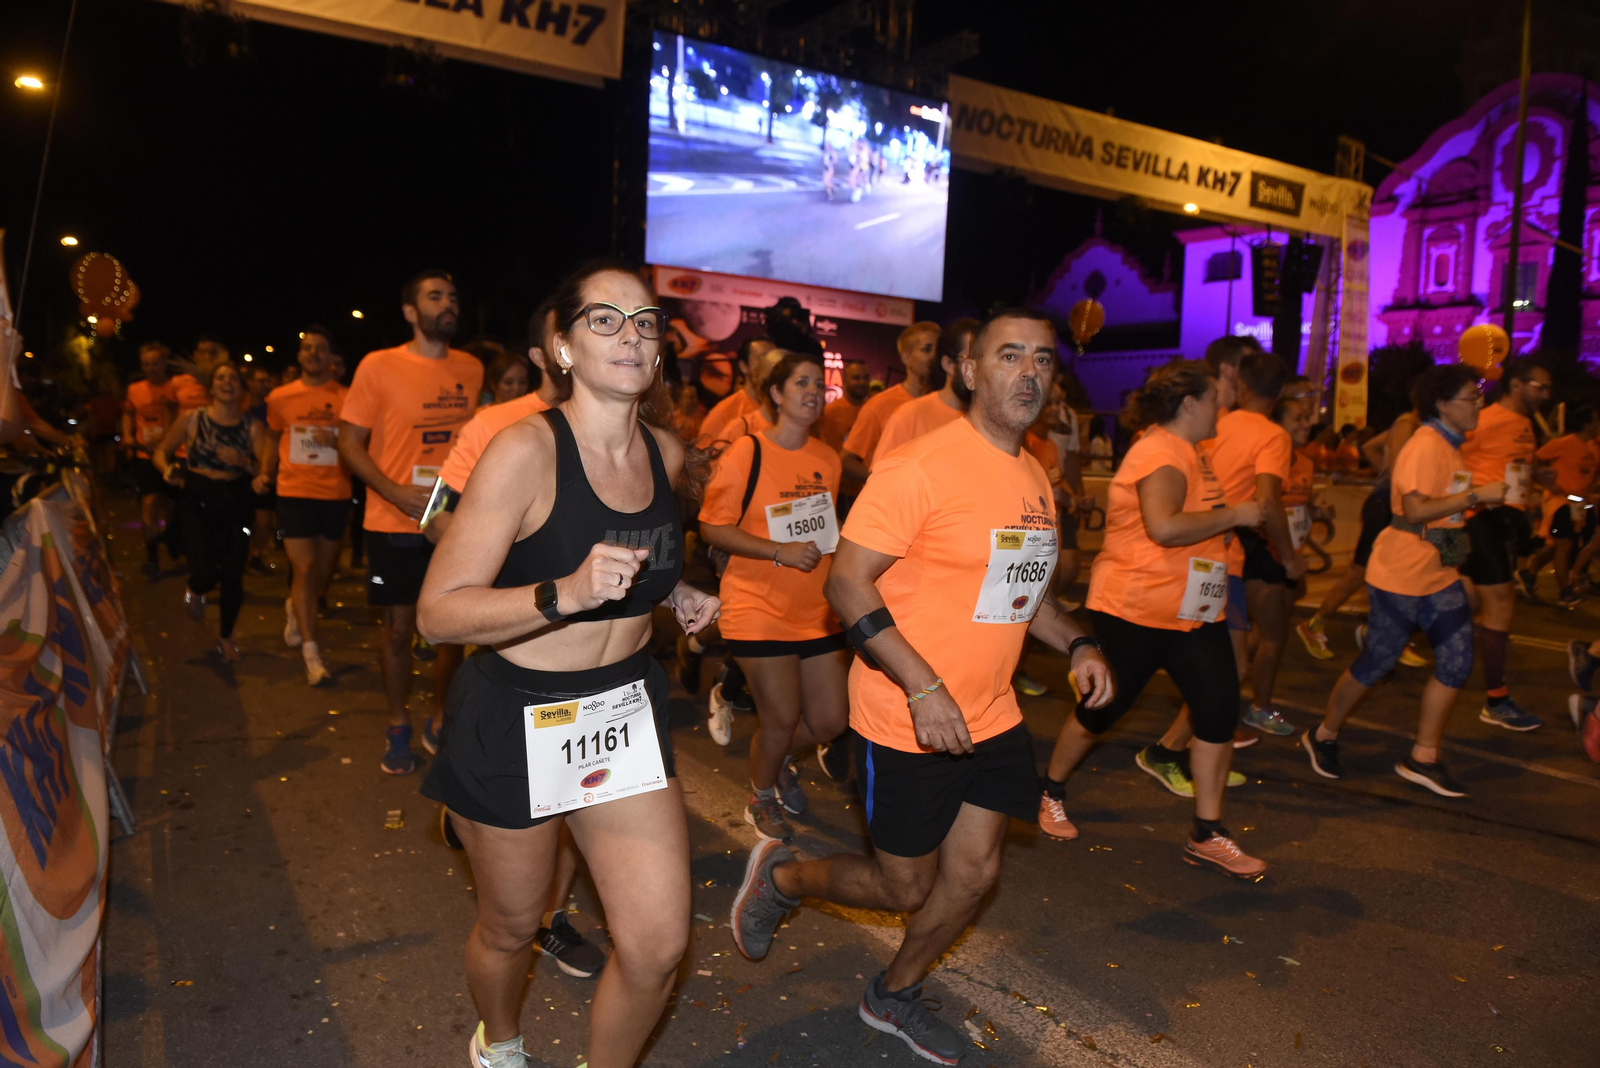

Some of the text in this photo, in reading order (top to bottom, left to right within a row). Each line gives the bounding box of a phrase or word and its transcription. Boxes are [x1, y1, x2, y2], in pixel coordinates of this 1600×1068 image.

[956, 104, 1094, 161] NOCTURNA
[1101, 141, 1190, 185] SEVILLA
[1234, 321, 1274, 341] Sevill
[786, 515, 825, 537] 15800
[1006, 561, 1048, 583] 11686
[1199, 581, 1226, 599] 16128
[612, 701, 632, 710] SEVILLA
[622, 692, 641, 701] NOCTURNA
[540, 708, 569, 718] Sevilla
[561, 722, 630, 765] 11161
[578, 761, 592, 770] PILAR
